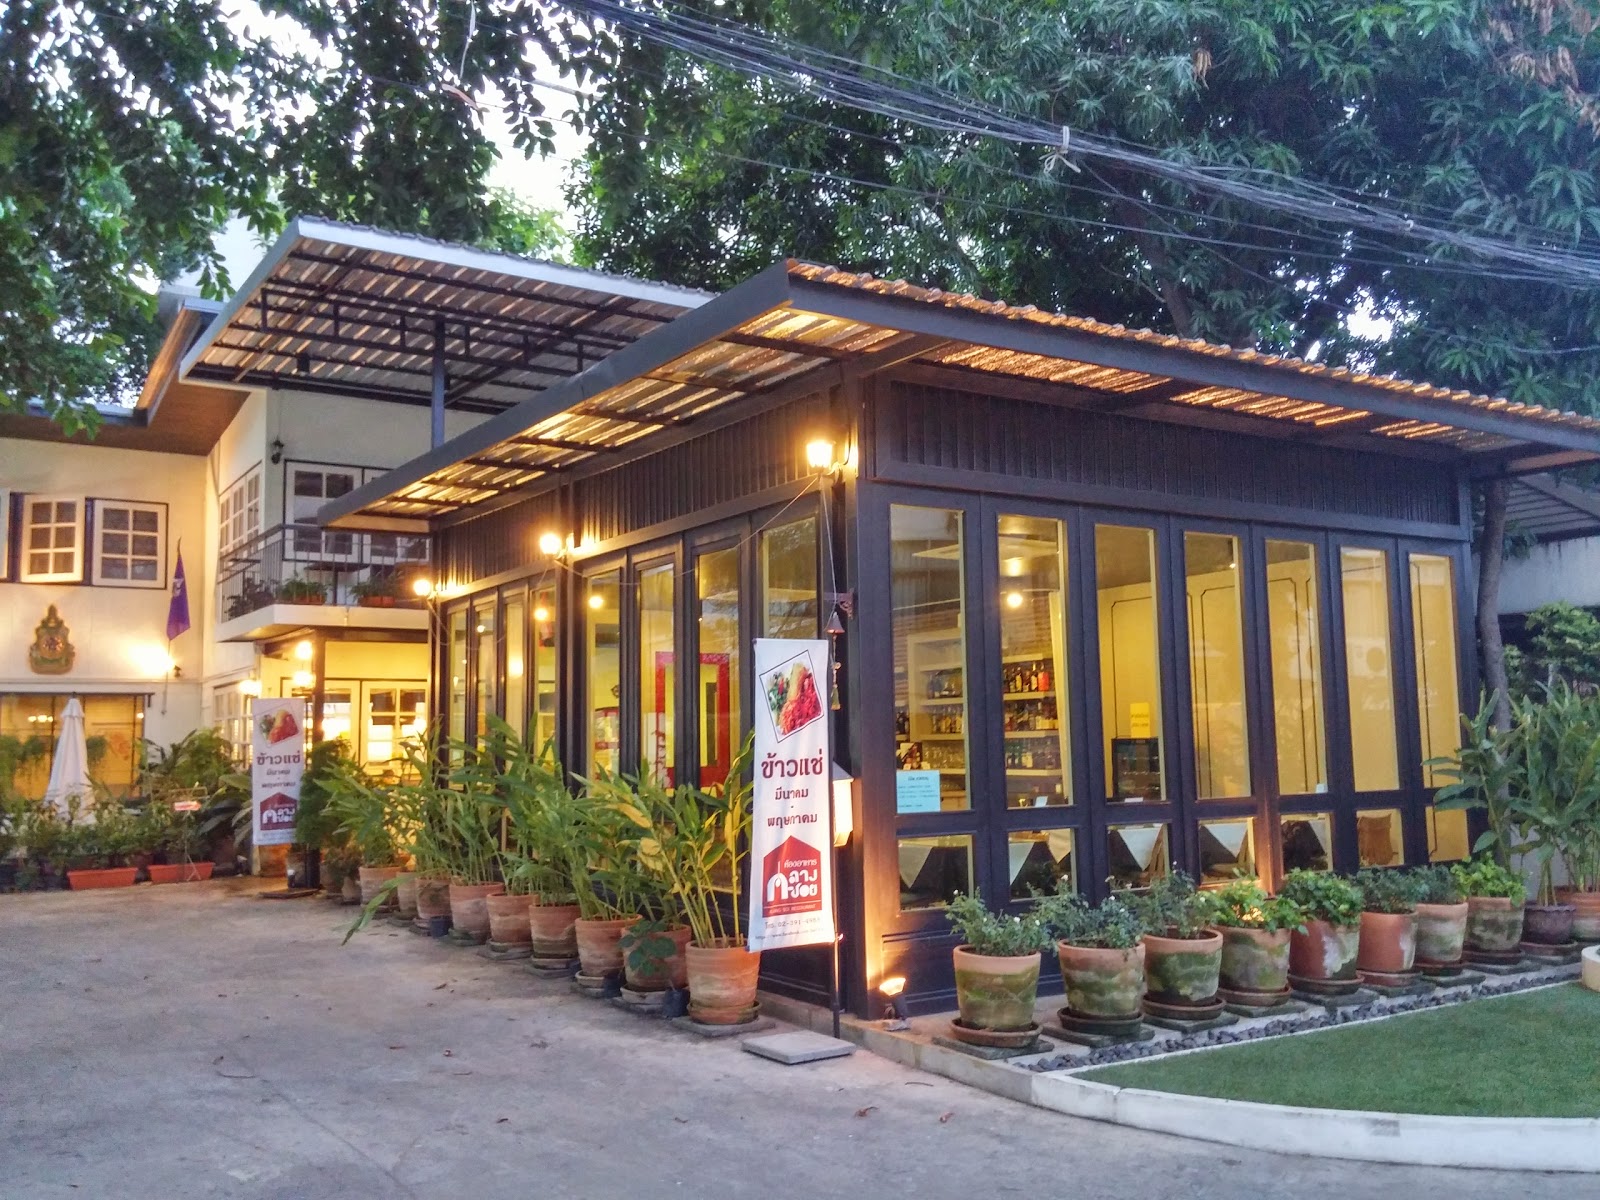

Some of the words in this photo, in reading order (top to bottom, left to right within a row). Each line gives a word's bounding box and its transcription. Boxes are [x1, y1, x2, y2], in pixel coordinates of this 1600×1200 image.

[256, 750, 301, 766] ข้าวแช่
[761, 748, 823, 779] ข้าวแช่
[775, 786, 809, 801] มีนาคม
[767, 813, 818, 829] พฤษภาคม
